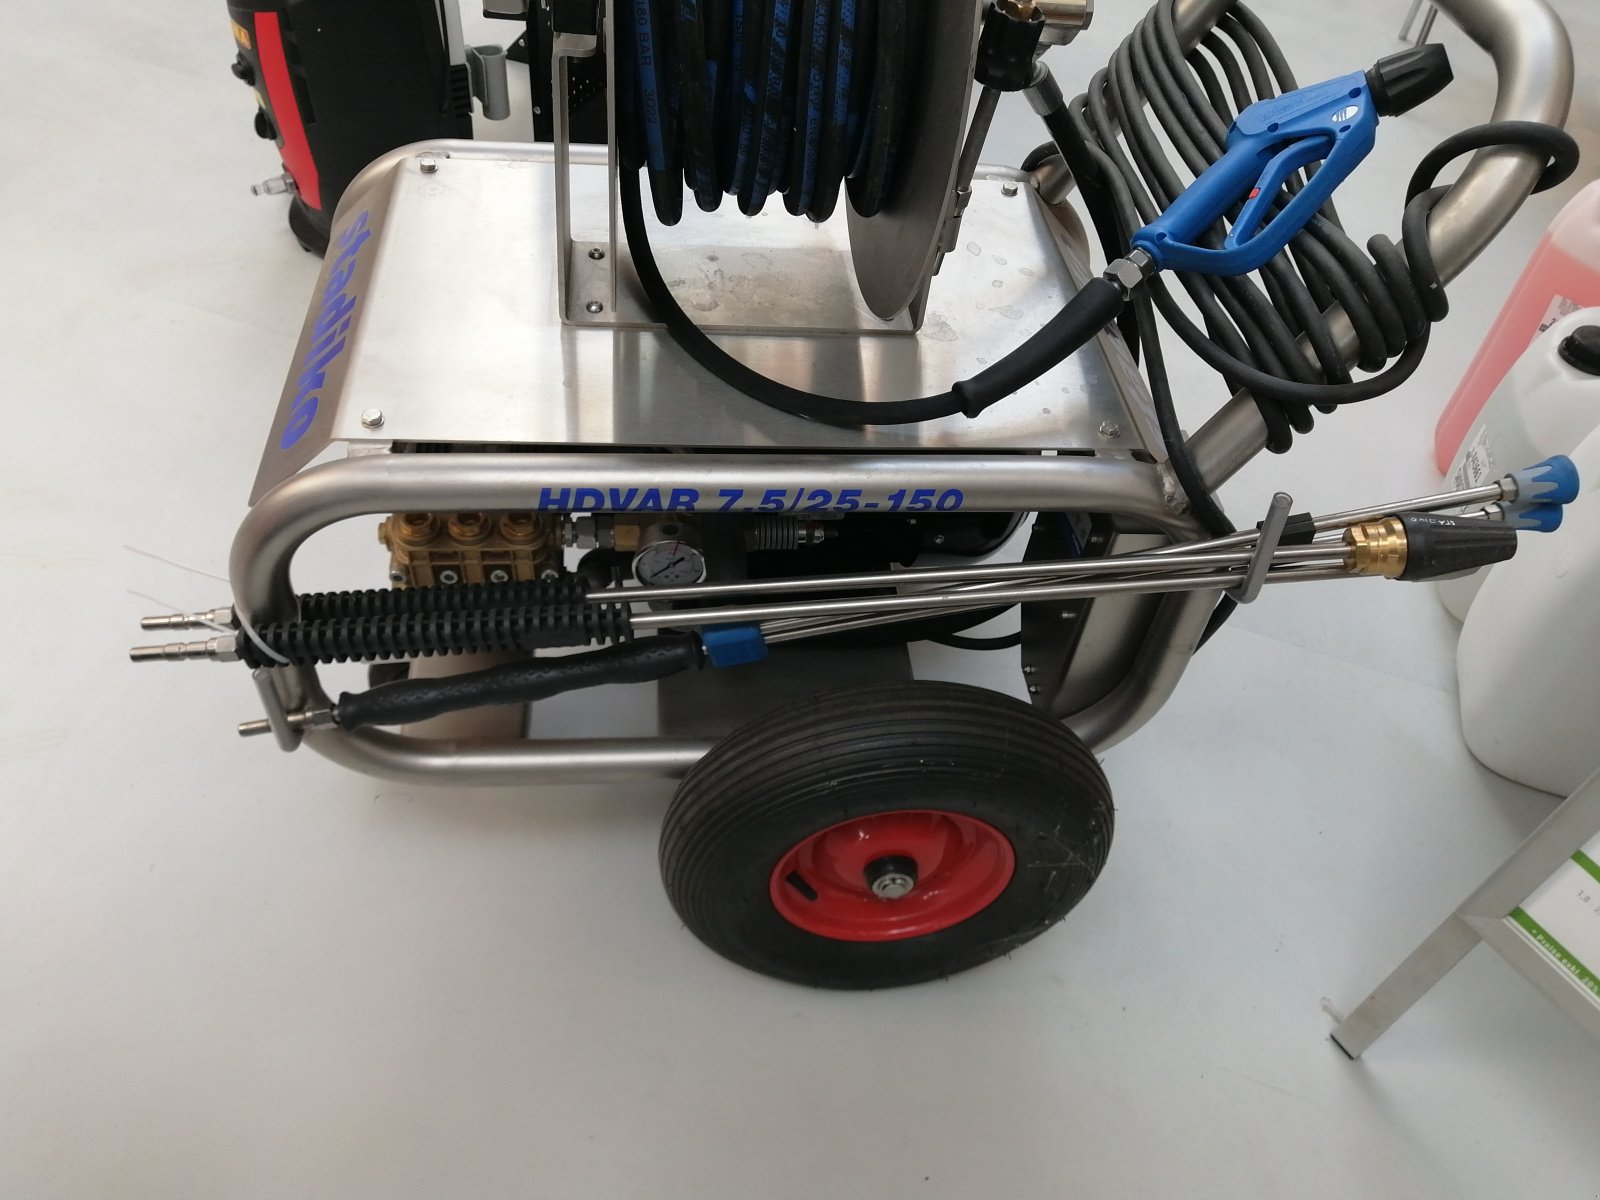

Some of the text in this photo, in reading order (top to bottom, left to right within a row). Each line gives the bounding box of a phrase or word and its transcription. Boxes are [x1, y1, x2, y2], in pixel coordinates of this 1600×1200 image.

[638, 32, 652, 66] BAR
[538, 487, 964, 512] HDVAR 7.5/25-150
